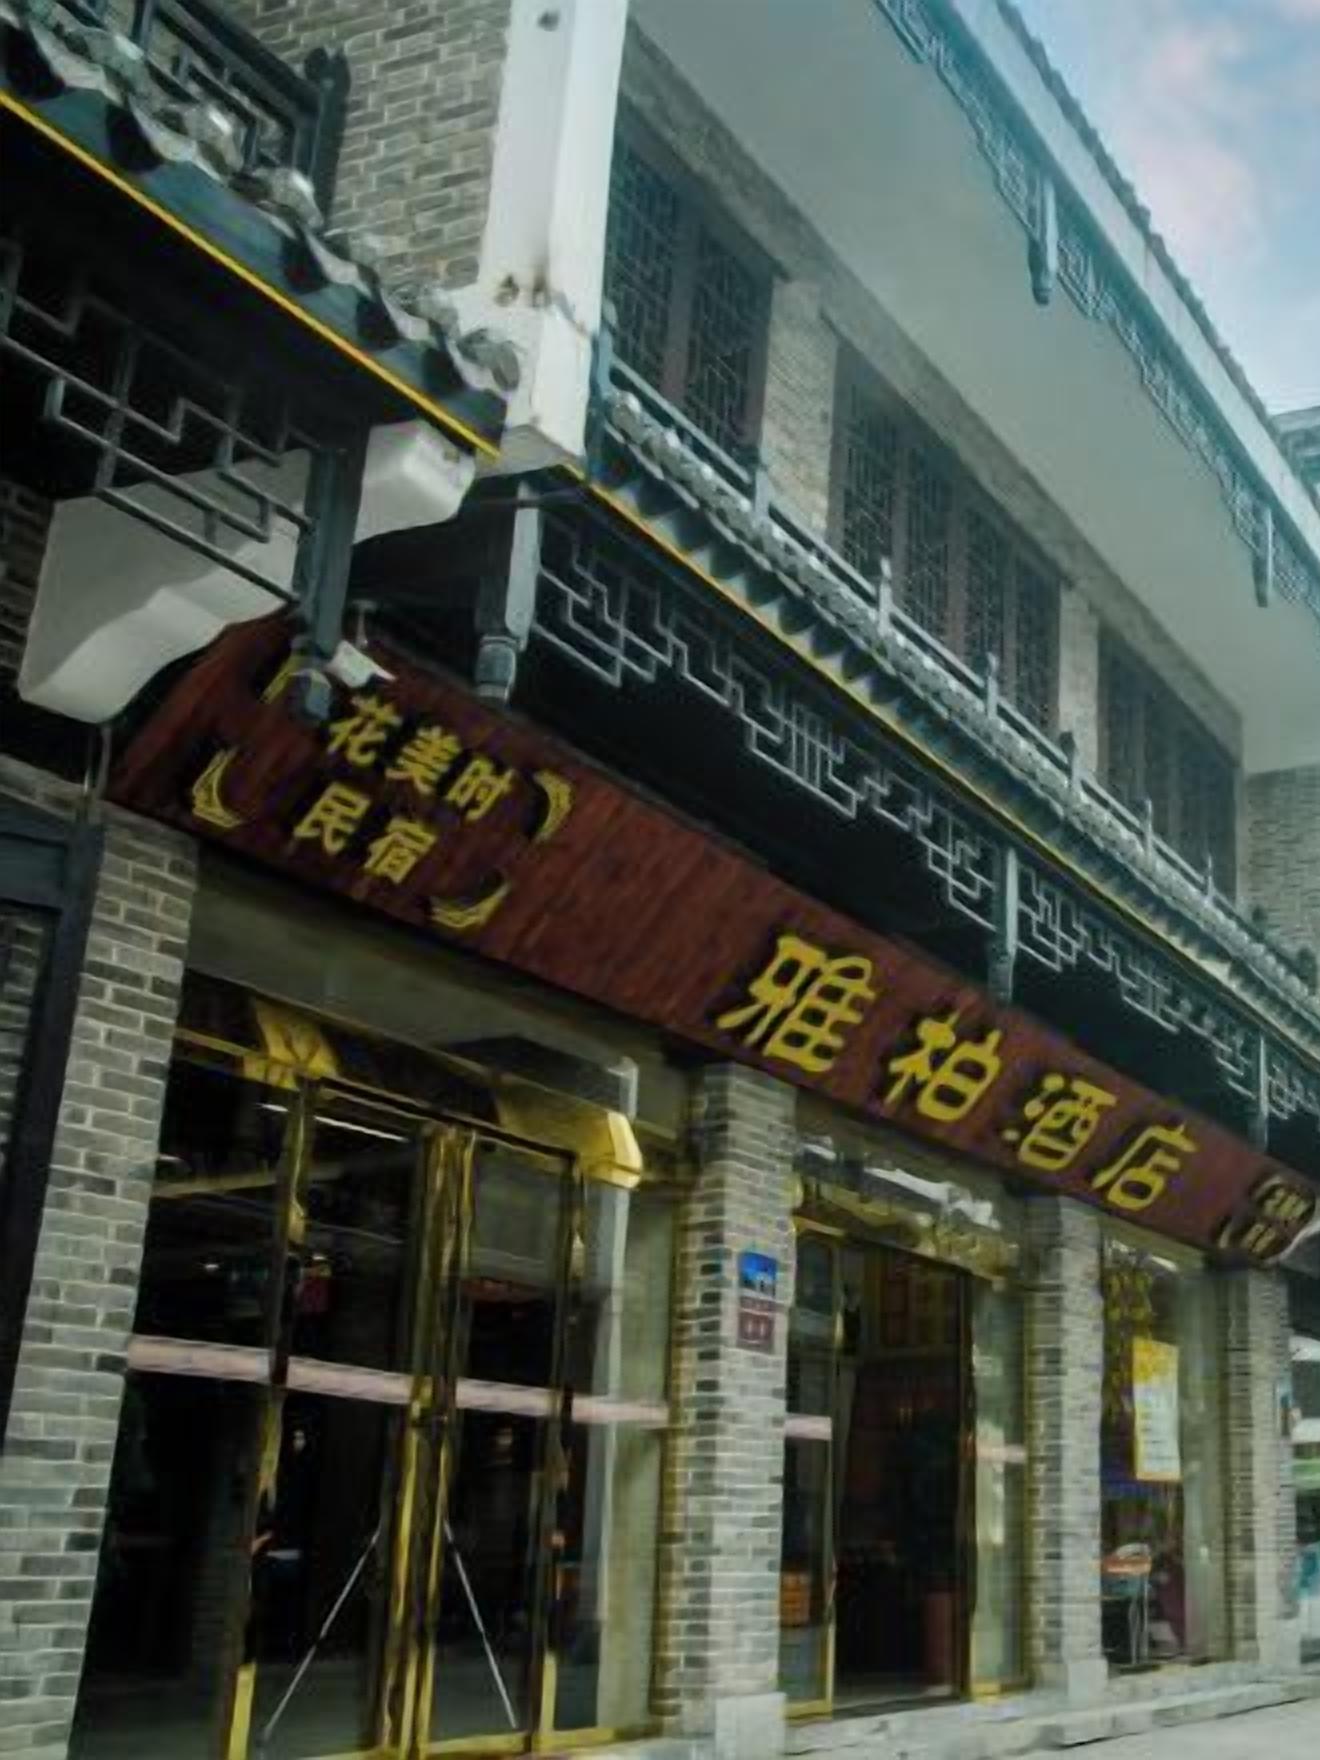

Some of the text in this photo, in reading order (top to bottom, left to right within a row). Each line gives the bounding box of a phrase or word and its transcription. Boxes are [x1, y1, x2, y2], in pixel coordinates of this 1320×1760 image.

[327, 696, 513, 820] 花美时
[294, 783, 438, 883] 民宿
[717, 935, 1196, 1212] 雅柏酒店
